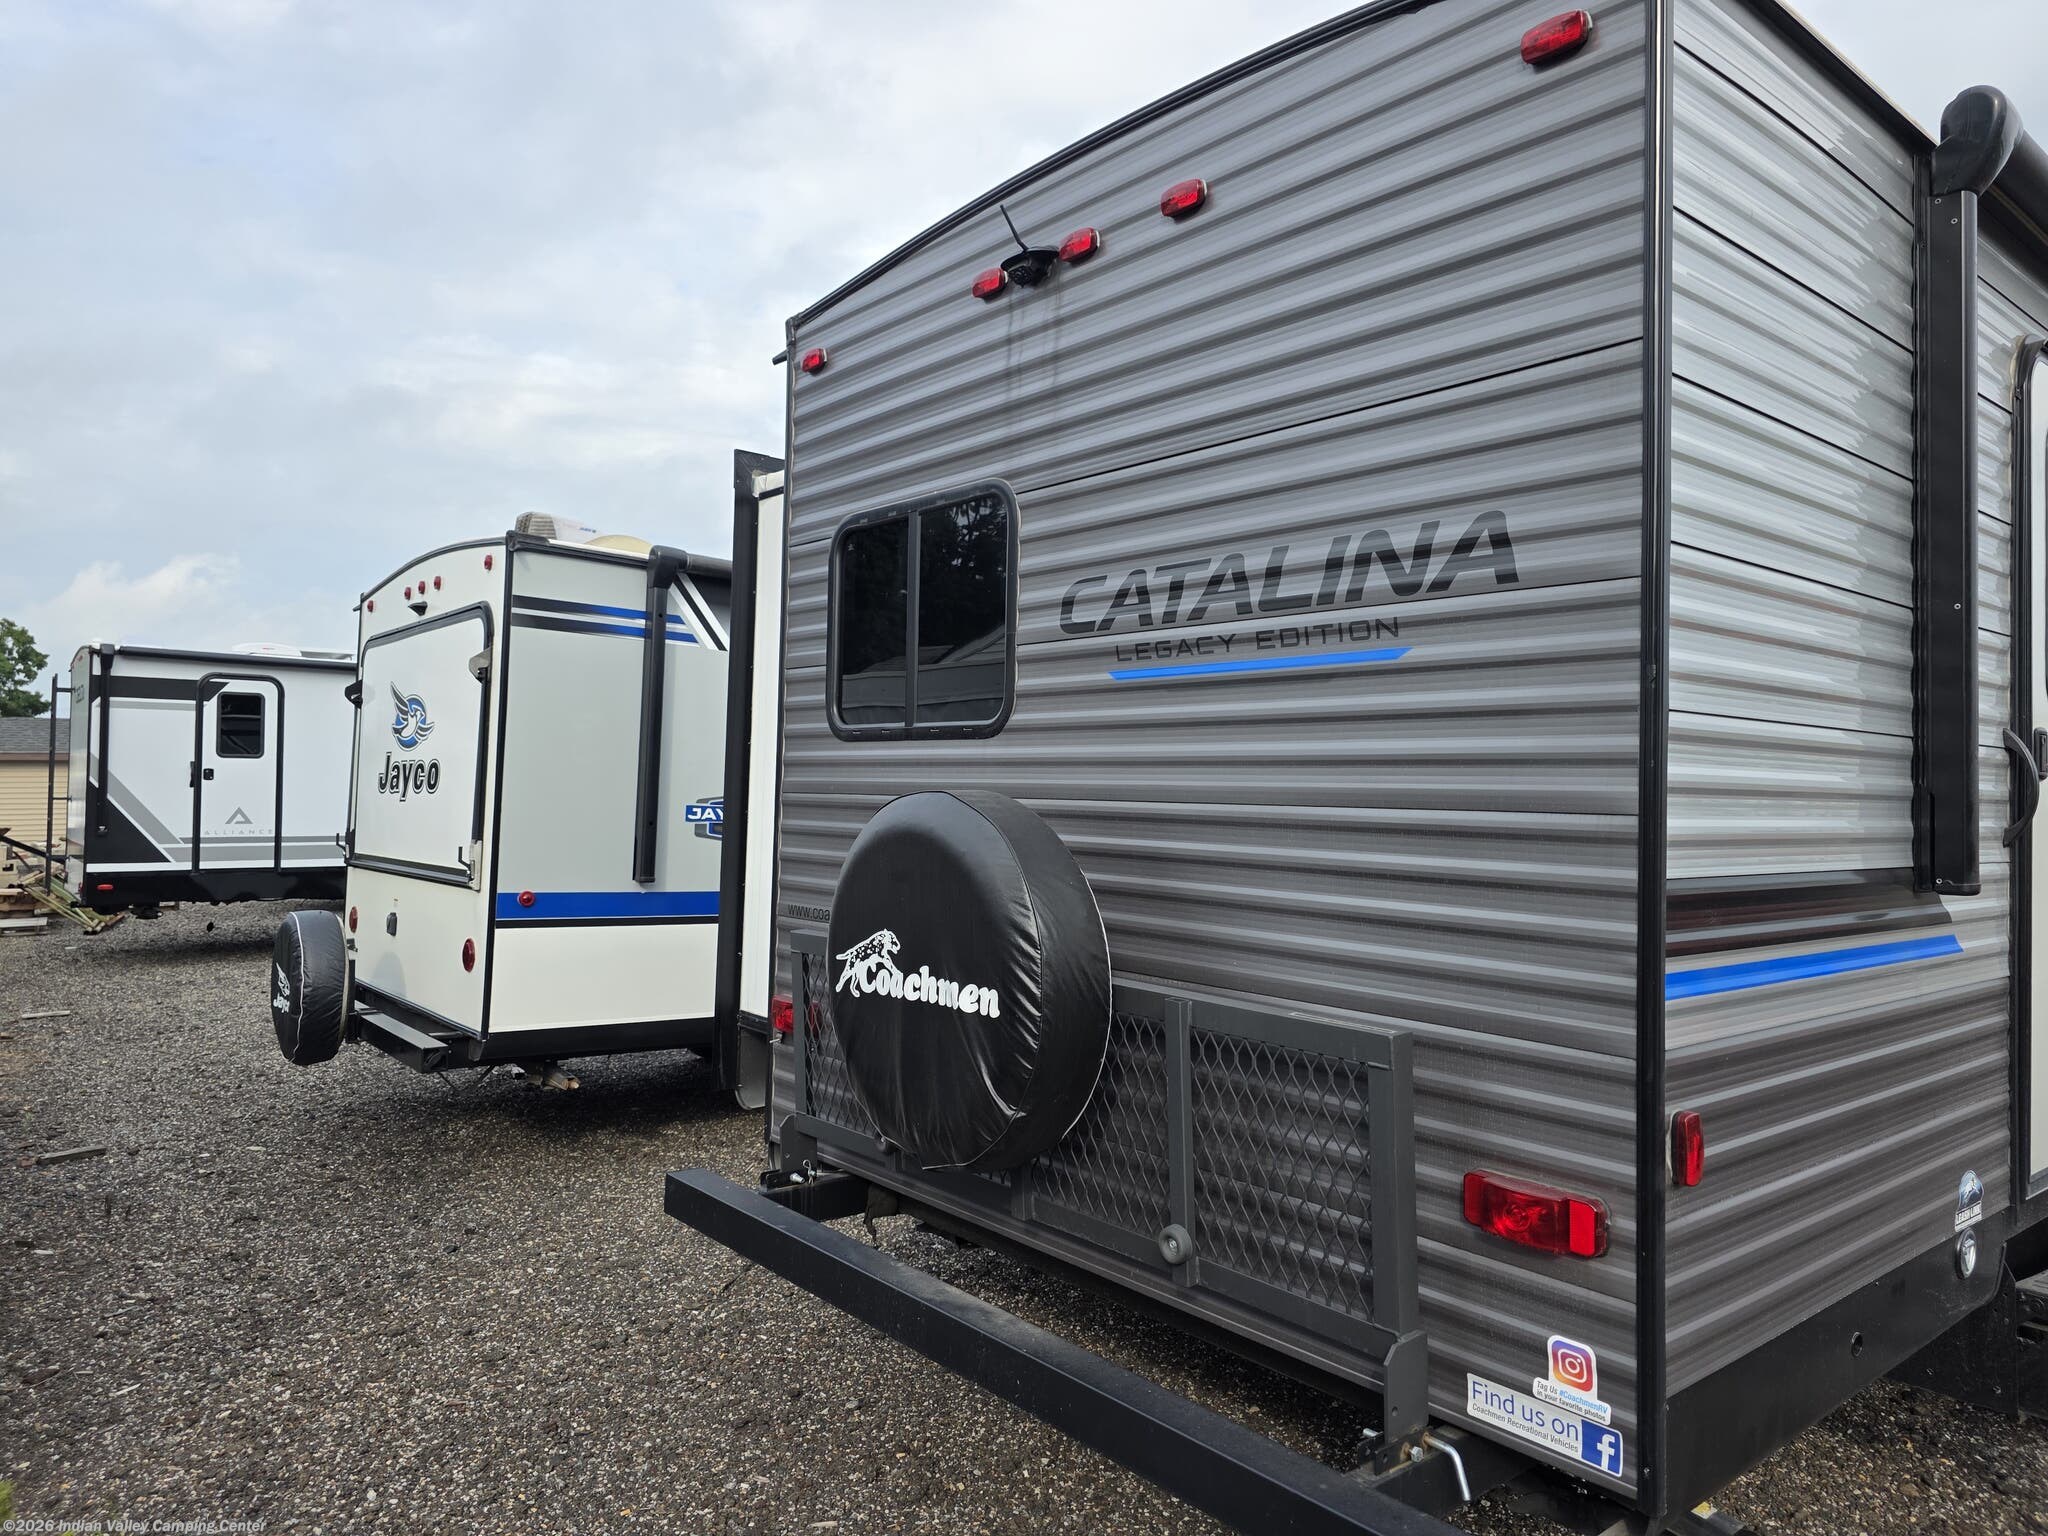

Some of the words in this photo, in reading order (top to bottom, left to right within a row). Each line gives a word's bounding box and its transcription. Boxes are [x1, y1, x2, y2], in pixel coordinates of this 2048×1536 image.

[1059, 510, 1520, 635] CATALINA
[1115, 633, 1237, 662] LEGACY
[1256, 617, 1399, 651] EDITION
[378, 752, 441, 802] Jayco
[204, 828, 274, 836] ALLIANCE
[858, 961, 1001, 1019] Coachmen
[1472, 1380, 1515, 1416] Find
[1521, 1404, 1546, 1428] us
[1551, 1417, 1579, 1442] on
[1536, 1381, 1549, 1393] Tag
[1549, 1385, 1558, 1395] Us
[1536, 1389, 1544, 1398] in
[1544, 1392, 1558, 1402] your
[1558, 1398, 1583, 1413] favorite
[1584, 1408, 1606, 1422] photos
[1472, 1403, 1506, 1423] Coachmen
[1507, 1416, 1549, 1441] Recreational
[1550, 1434, 1579, 1453] Vehicles
